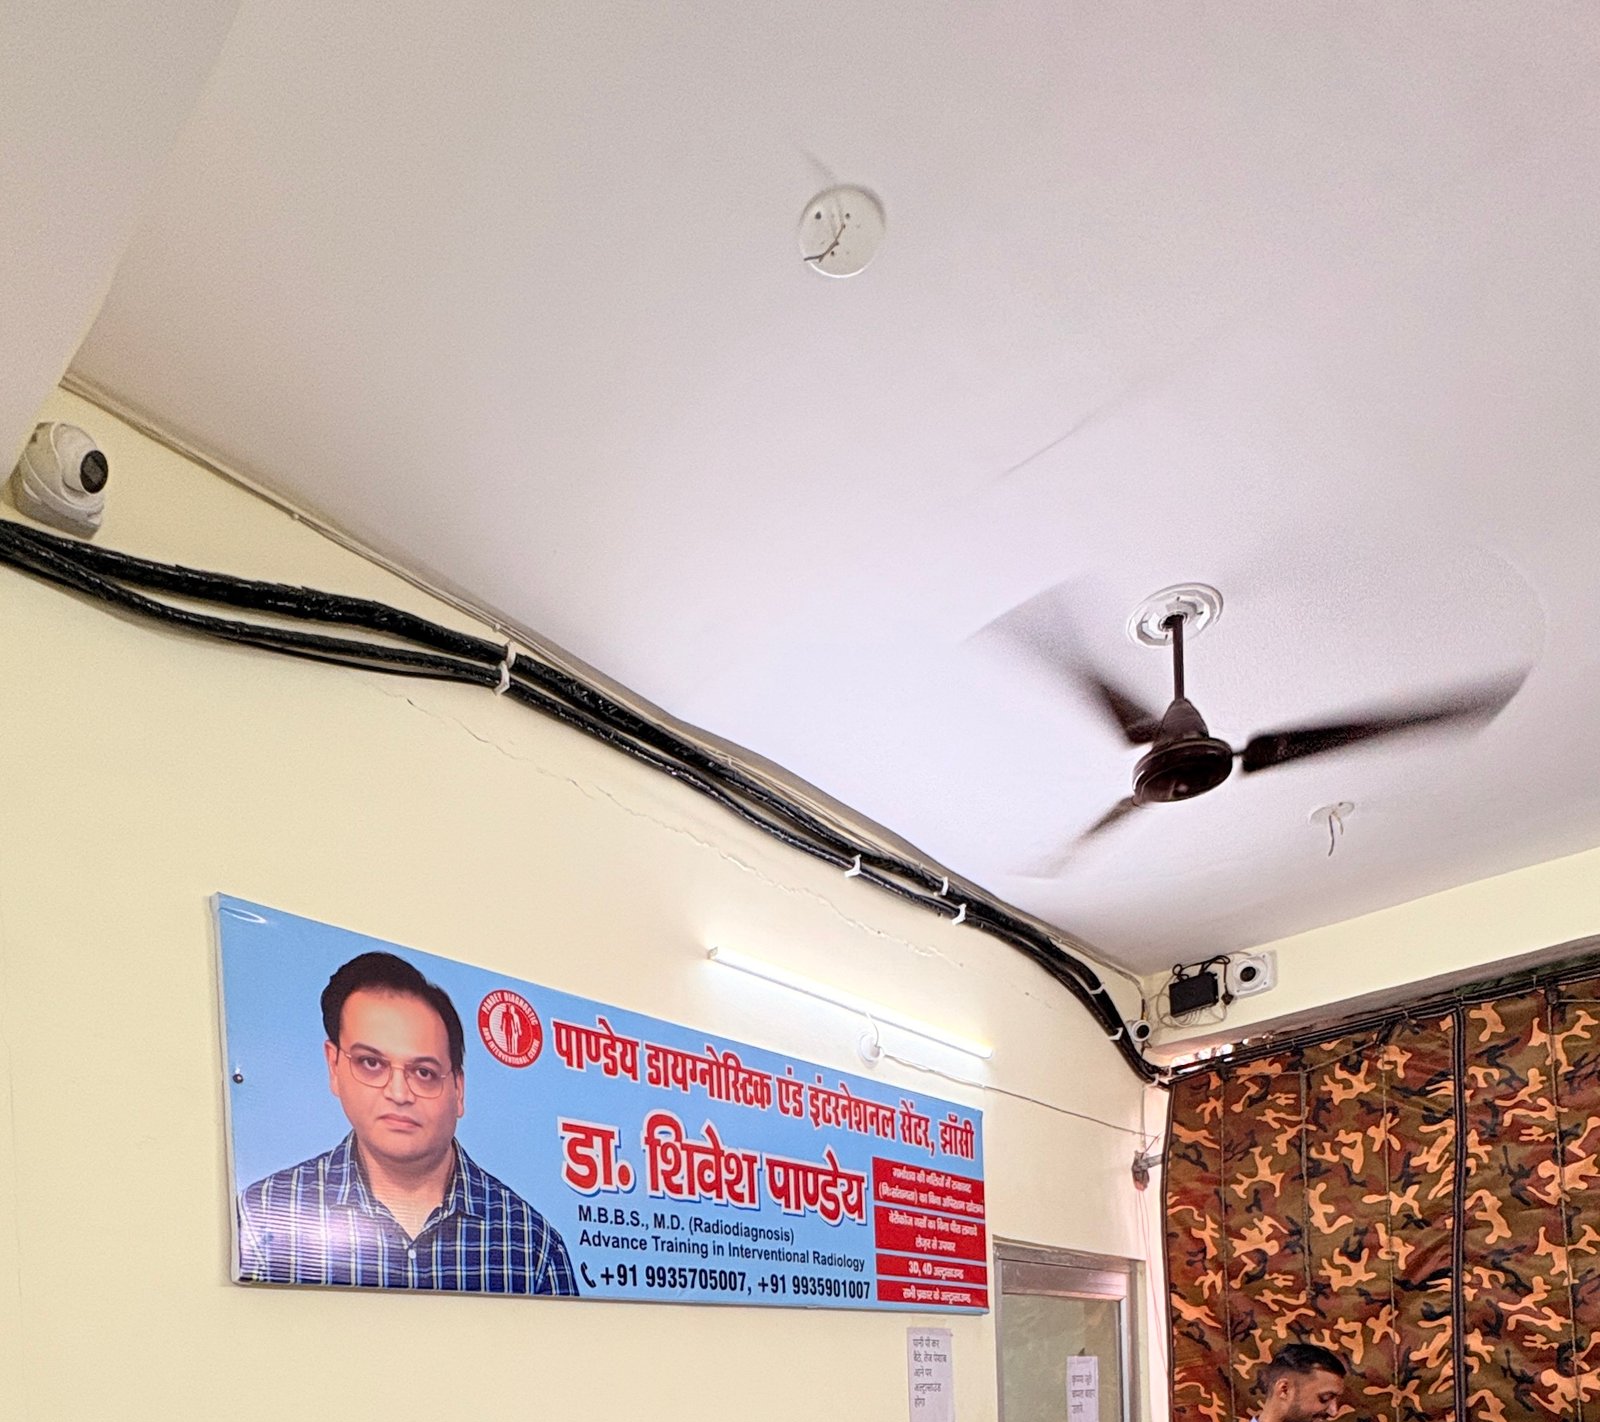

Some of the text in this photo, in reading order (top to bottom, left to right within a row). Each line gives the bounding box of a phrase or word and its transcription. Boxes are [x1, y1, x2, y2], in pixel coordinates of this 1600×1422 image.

[553, 1018, 639, 1081] पाण्डेय
[645, 1046, 772, 1109] डायग्नोस्टिक
[776, 1067, 803, 1117] एंड
[808, 1076, 895, 1140] इंटरनेशनल
[900, 1101, 935, 1156] सेंटर,
[562, 1114, 866, 1221] डा. शिवेश पाण्डेय
[578, 1205, 794, 1246] M.B.B.S., M.D. (Radiodiagnosis)
[580, 1229, 865, 1272] Advance Training in Interventional Radiology
[908, 1260, 921, 1276] 3D,
[922, 1262, 932, 1275] 4D
[600, 1263, 870, 1299] +91 9935705007, +91 9935901007
